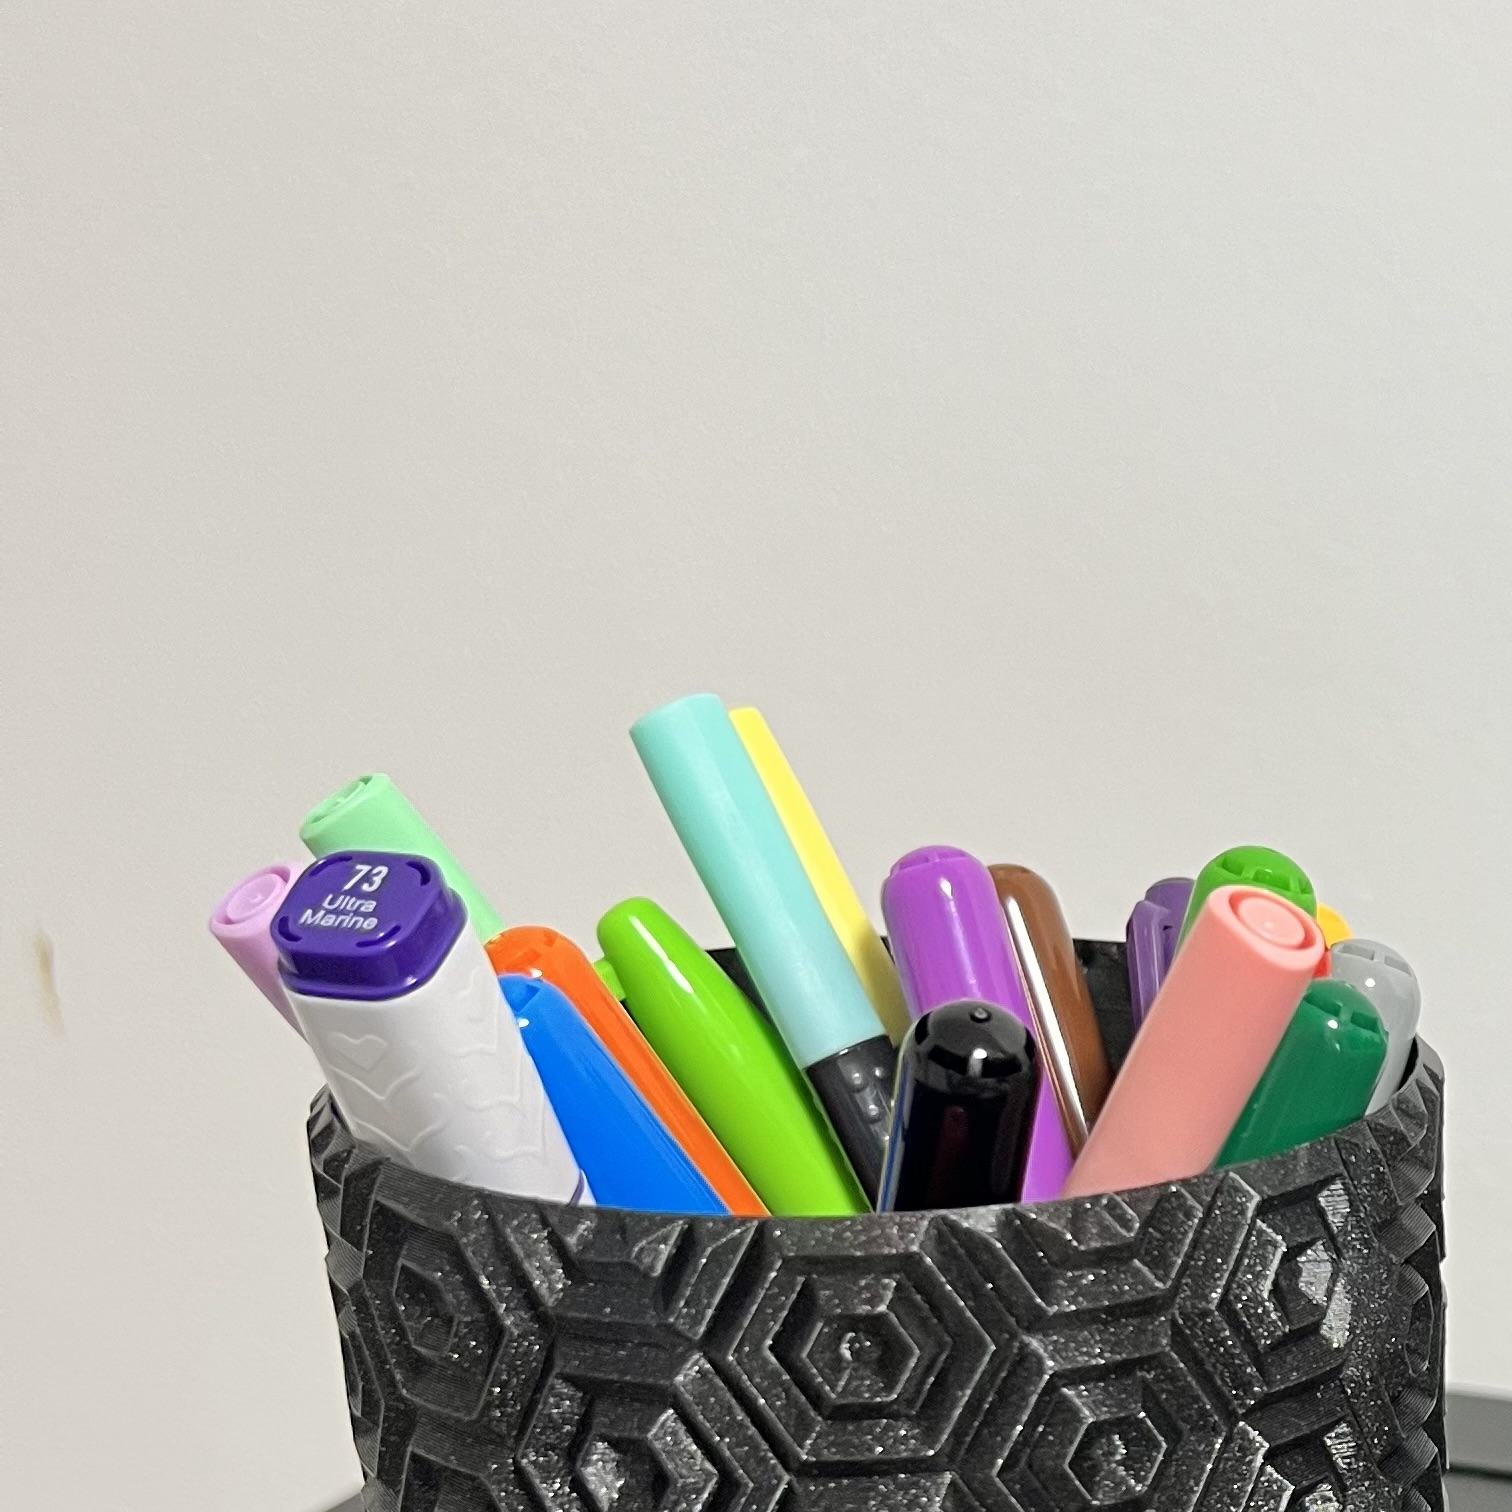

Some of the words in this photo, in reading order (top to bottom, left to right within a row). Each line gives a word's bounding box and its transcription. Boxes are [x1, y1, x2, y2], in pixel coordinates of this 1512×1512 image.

[342, 864, 389, 892] 73
[322, 894, 377, 912] Ultra
[300, 908, 378, 930] Marine
